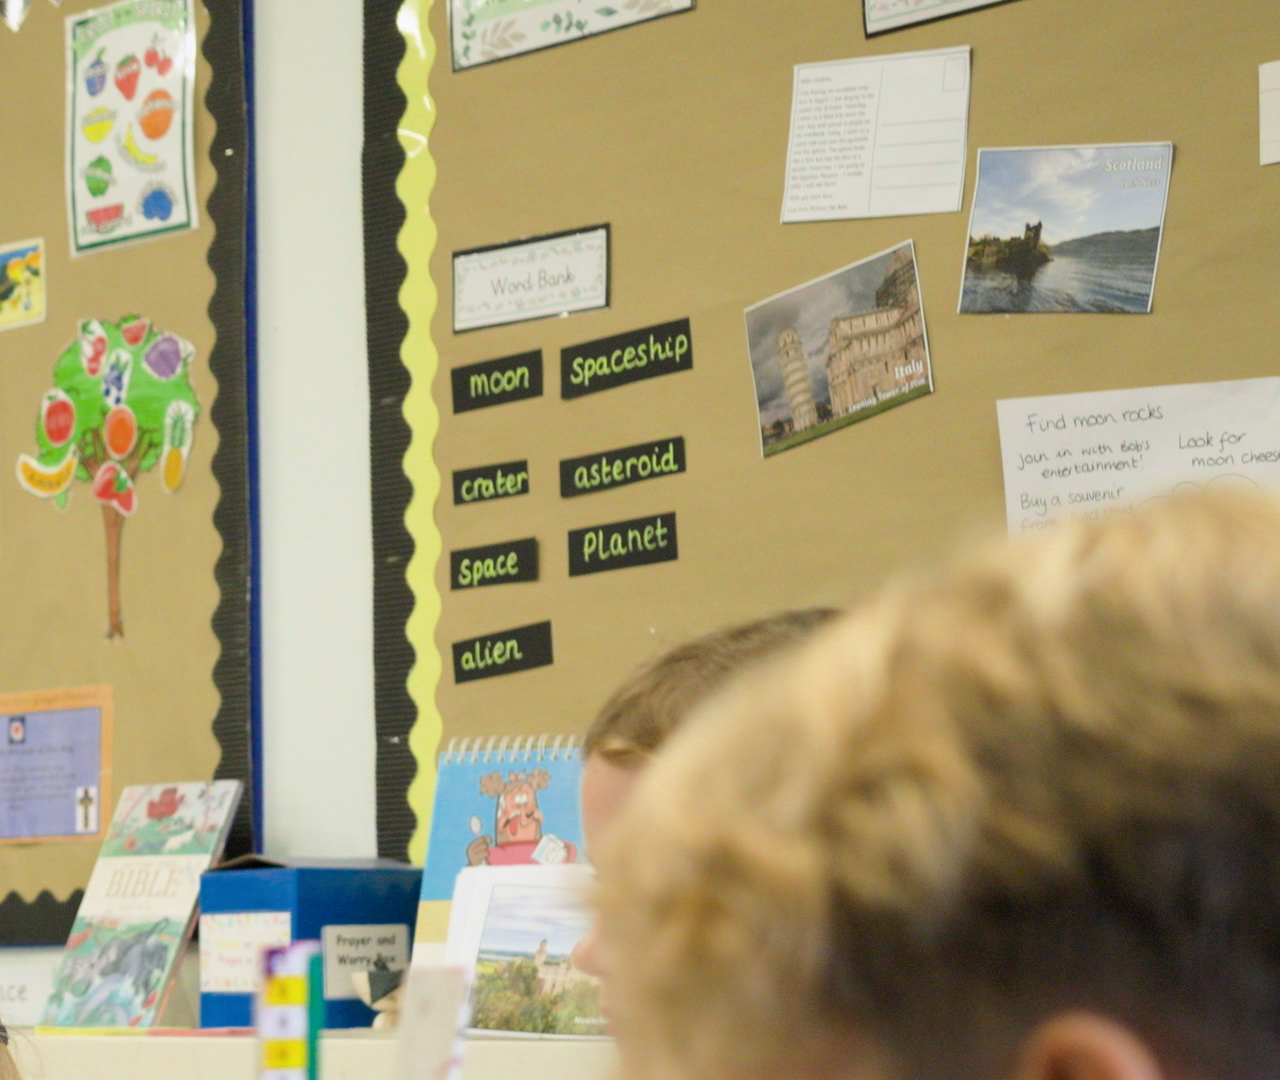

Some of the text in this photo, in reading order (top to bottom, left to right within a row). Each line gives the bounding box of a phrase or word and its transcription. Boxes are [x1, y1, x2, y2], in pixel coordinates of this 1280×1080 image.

[1104, 156, 1162, 172] Scotland
[491, 264, 576, 297] Word Bank
[469, 364, 531, 398] moon
[894, 359, 924, 380] Italy
[1025, 404, 1164, 434] Find moon rocks
[1081, 442, 1112, 457] with
[1178, 431, 1247, 453] Look for
[574, 442, 679, 489] asteroid
[1041, 455, 1145, 480] entertainment!
[1191, 453, 1235, 468] moon
[460, 468, 528, 502] crater
[1020, 493, 1048, 517] Buy
[1051, 494, 1062, 507] a
[1068, 484, 1126, 506] souvenir
[460, 638, 523, 671] alien
[105, 867, 181, 899] BIBLE
[336, 932, 397, 949] Prayer and
[337, 953, 372, 968] Worry
